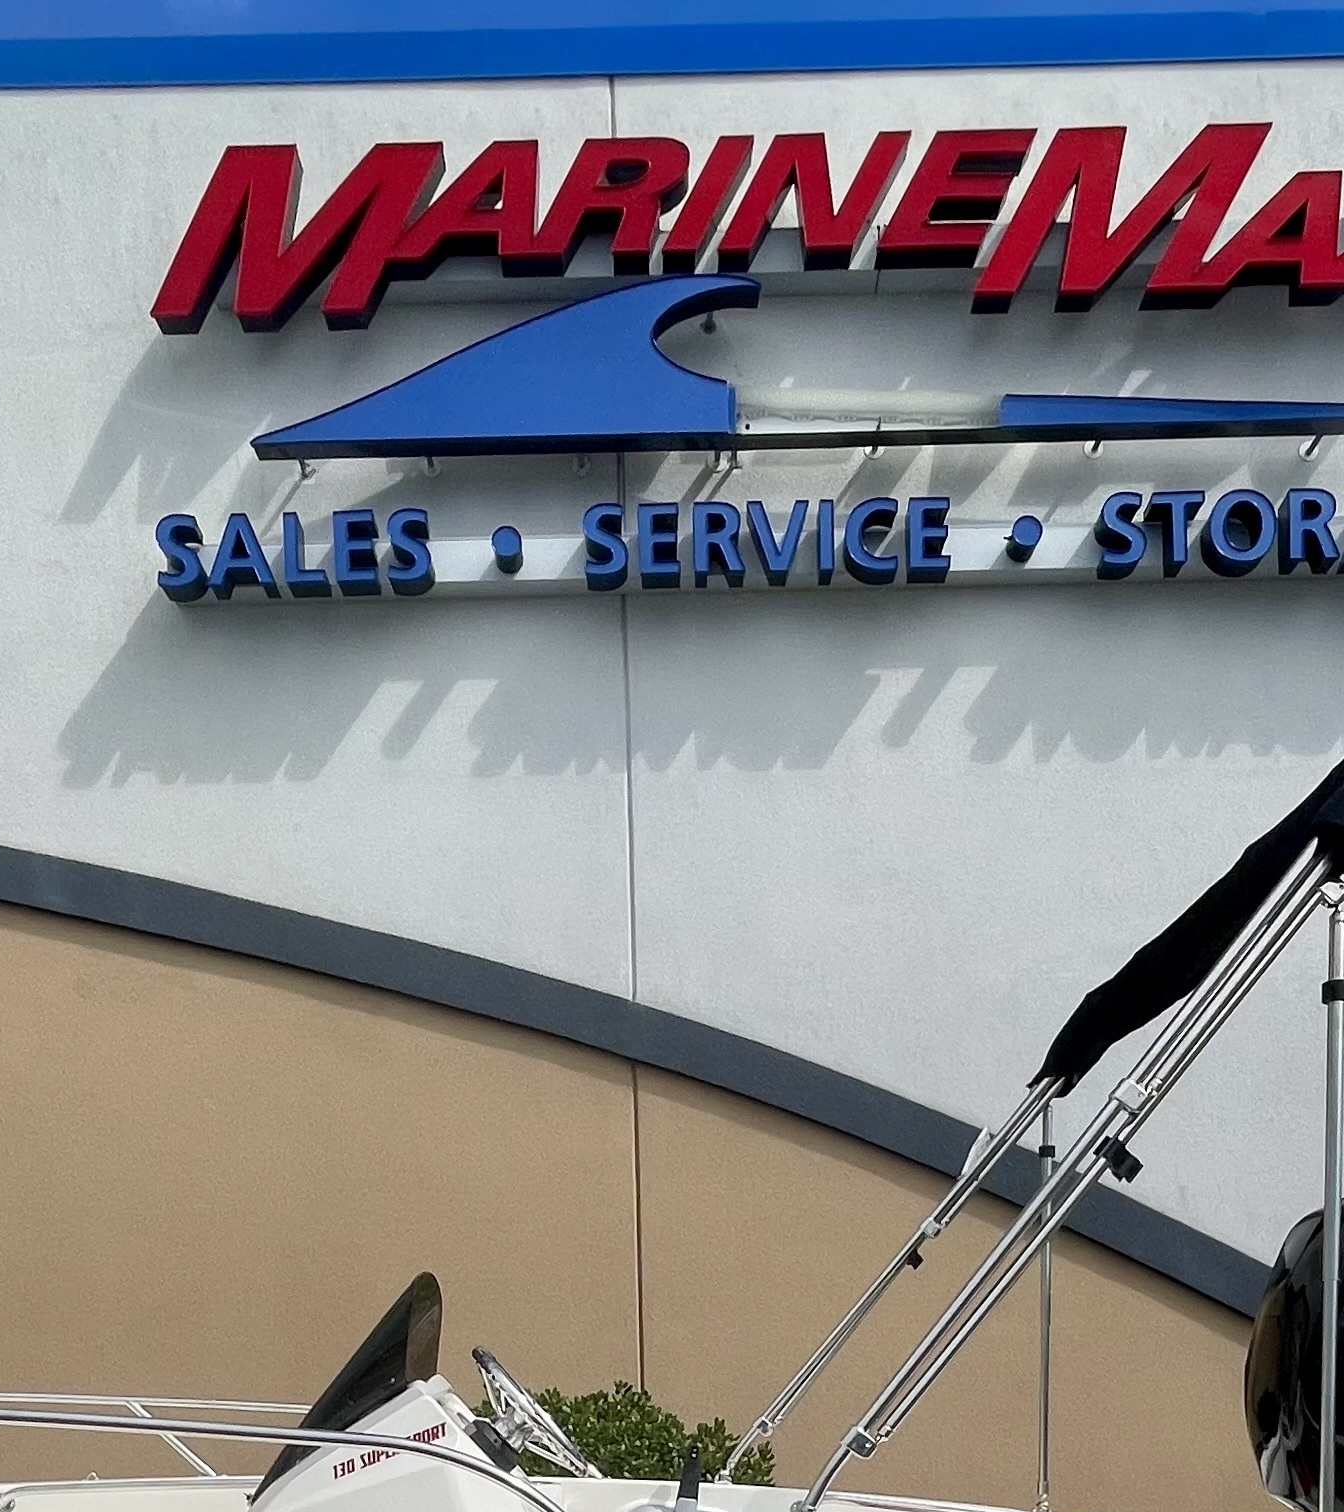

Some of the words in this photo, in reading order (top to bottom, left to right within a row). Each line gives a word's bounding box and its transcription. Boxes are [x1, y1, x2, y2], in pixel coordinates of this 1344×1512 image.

[156, 506, 436, 602] SALES
[582, 496, 951, 592] SERVICE
[332, 1457, 356, 1480] 130
[359, 1448, 401, 1470] SUP
[406, 1421, 447, 1444] PORT
